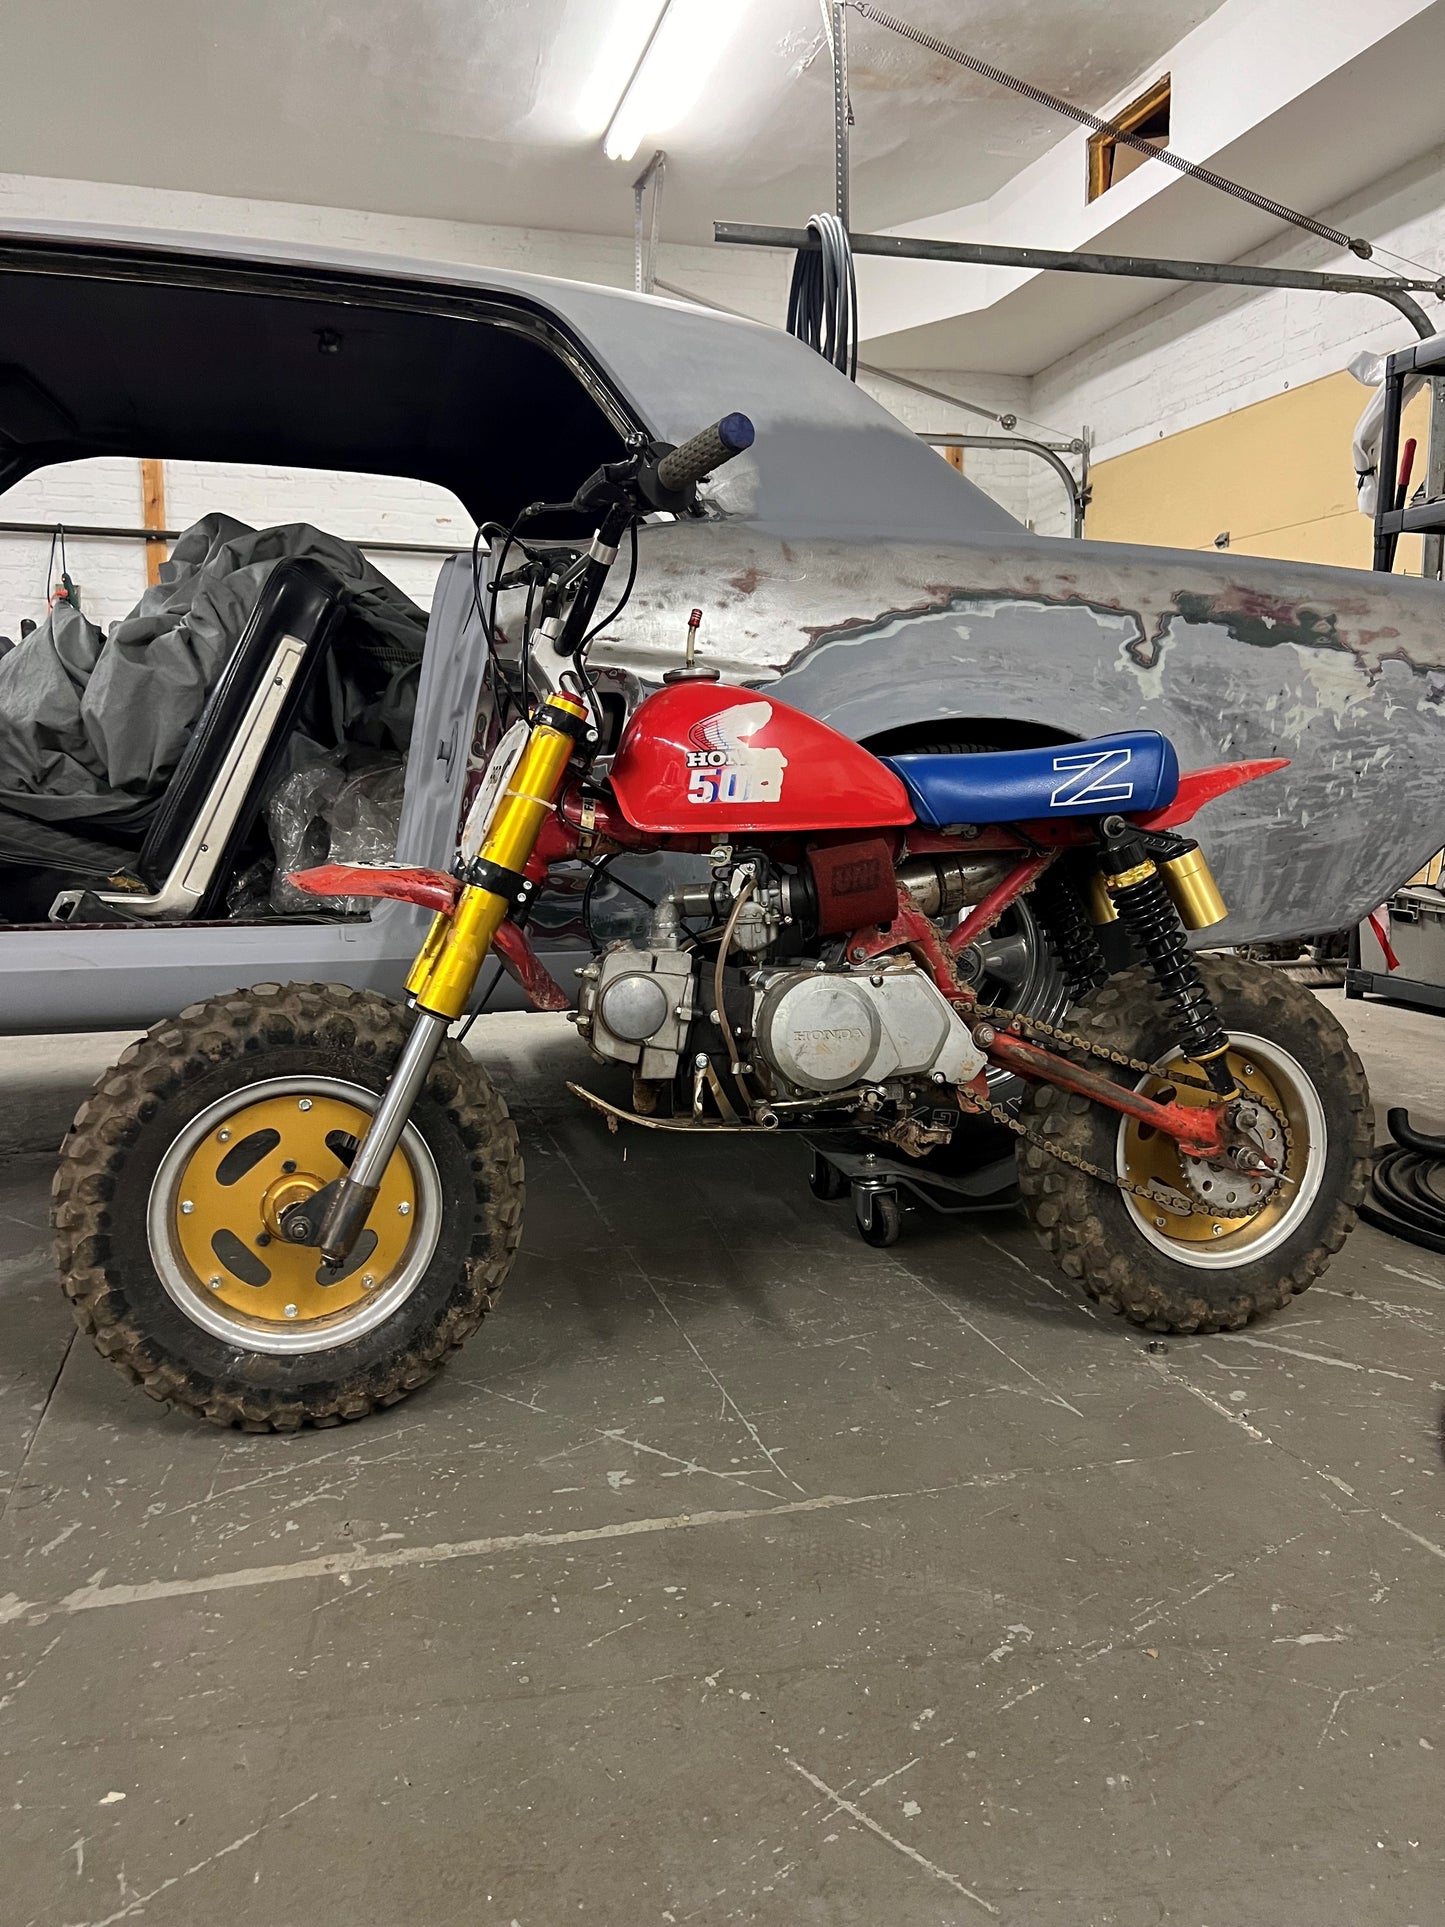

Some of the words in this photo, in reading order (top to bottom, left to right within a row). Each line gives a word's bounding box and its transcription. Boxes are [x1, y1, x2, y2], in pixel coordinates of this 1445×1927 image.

[686, 750, 755, 767] HON
[1050, 749, 1133, 807] Z
[793, 1027, 865, 1042] HONDA
